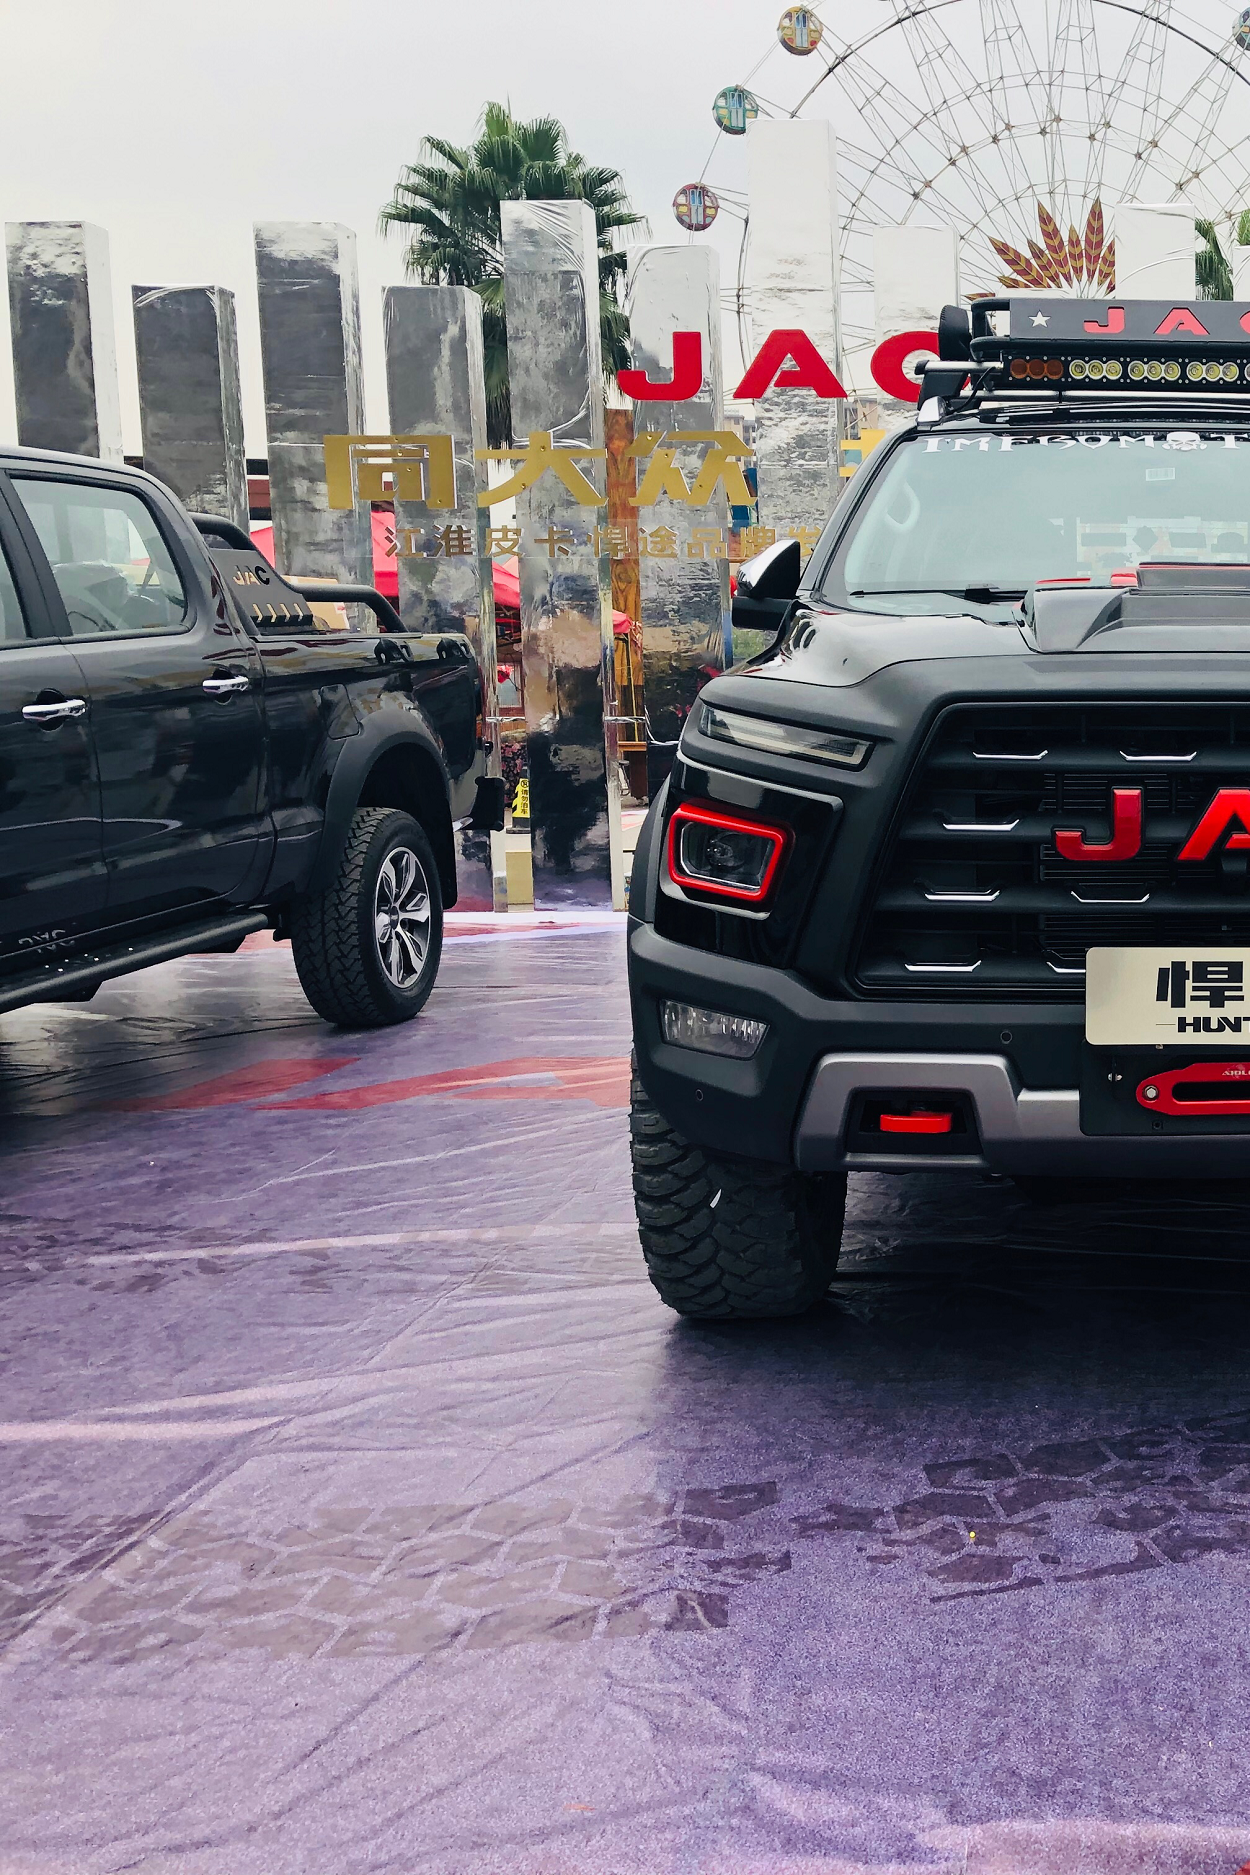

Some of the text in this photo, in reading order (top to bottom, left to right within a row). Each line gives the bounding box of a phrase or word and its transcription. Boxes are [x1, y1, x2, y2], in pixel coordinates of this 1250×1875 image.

[322, 430, 757, 510] 同大众
[233, 565, 270, 586] JAC
